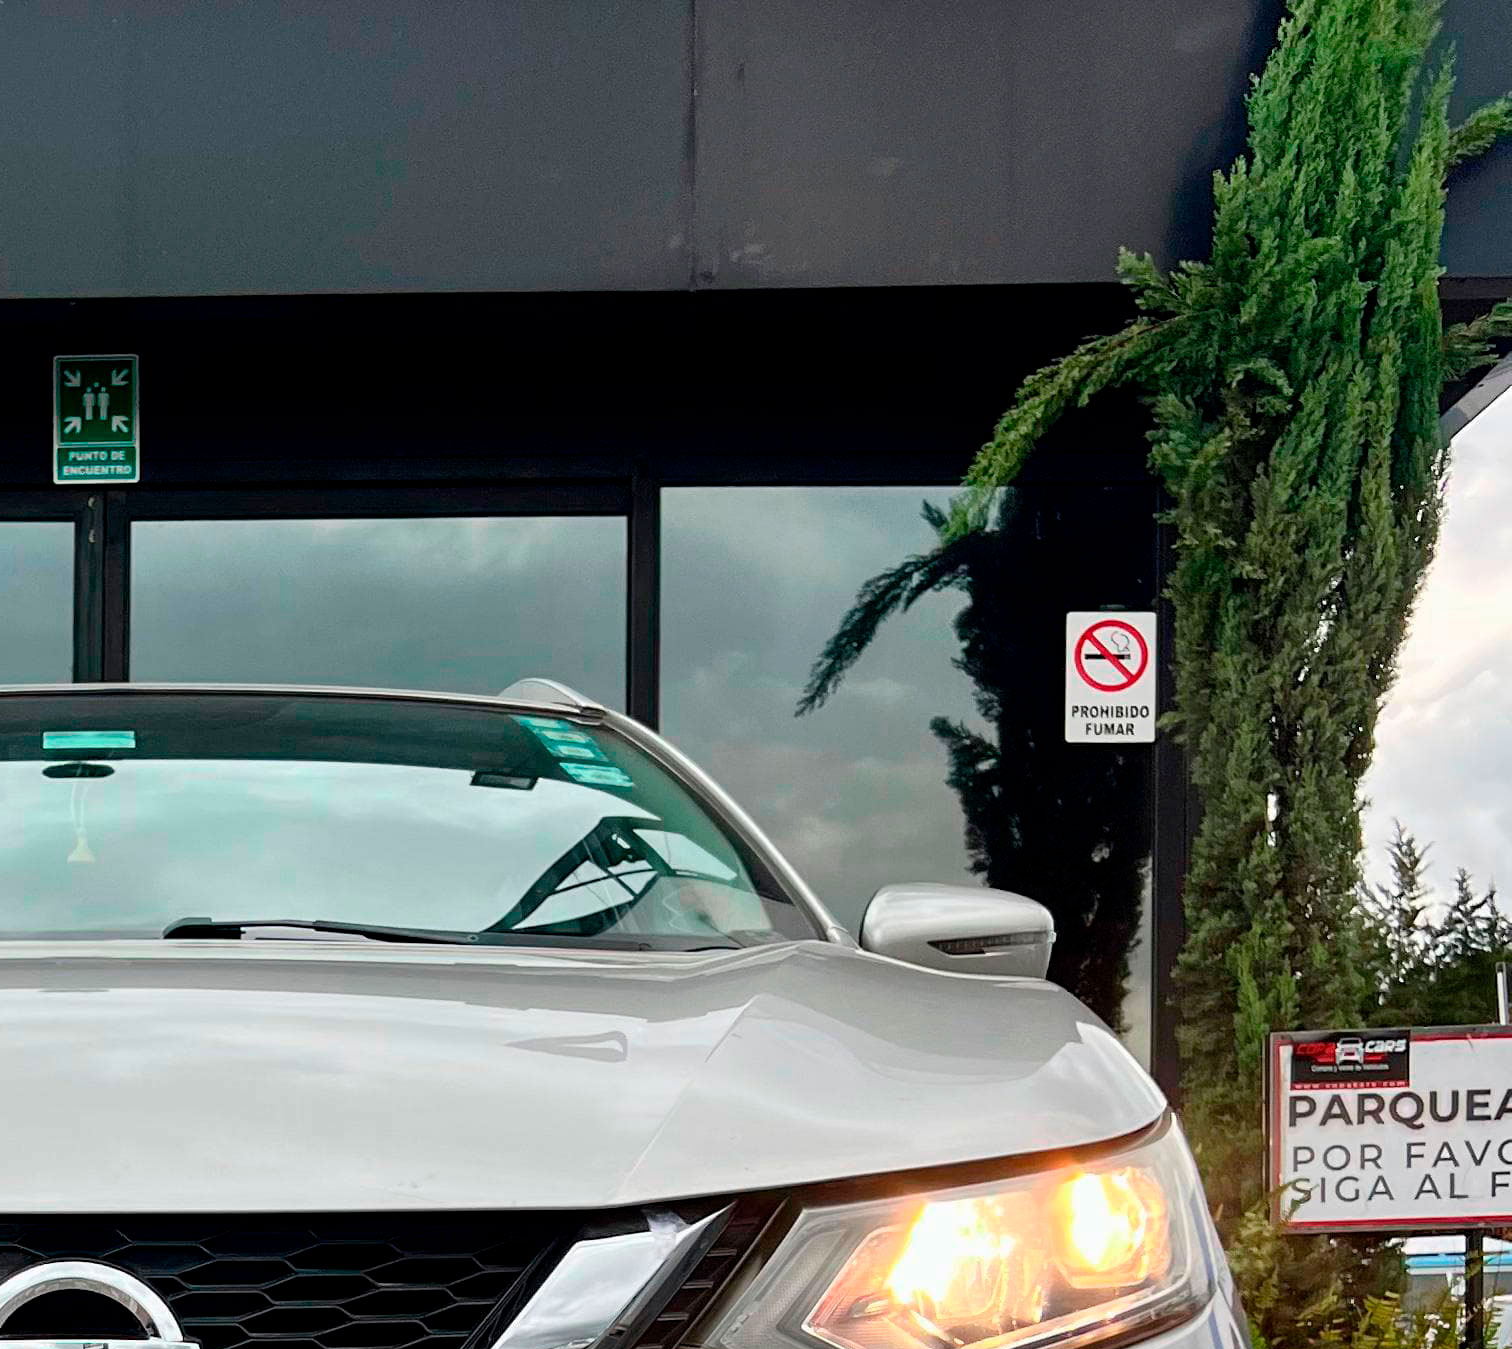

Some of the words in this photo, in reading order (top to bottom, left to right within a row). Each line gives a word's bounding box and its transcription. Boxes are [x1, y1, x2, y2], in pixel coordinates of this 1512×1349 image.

[69, 451, 108, 461] PUNTO
[111, 451, 126, 460] DE
[63, 465, 132, 475] ENCUENTRO
[1072, 705, 1149, 718] PROHIBIDO
[1086, 723, 1135, 735] FUMAR
[1293, 1144, 1383, 1172] POR
[1291, 1173, 1394, 1203] SIGA
[1415, 1173, 1469, 1200] AL
